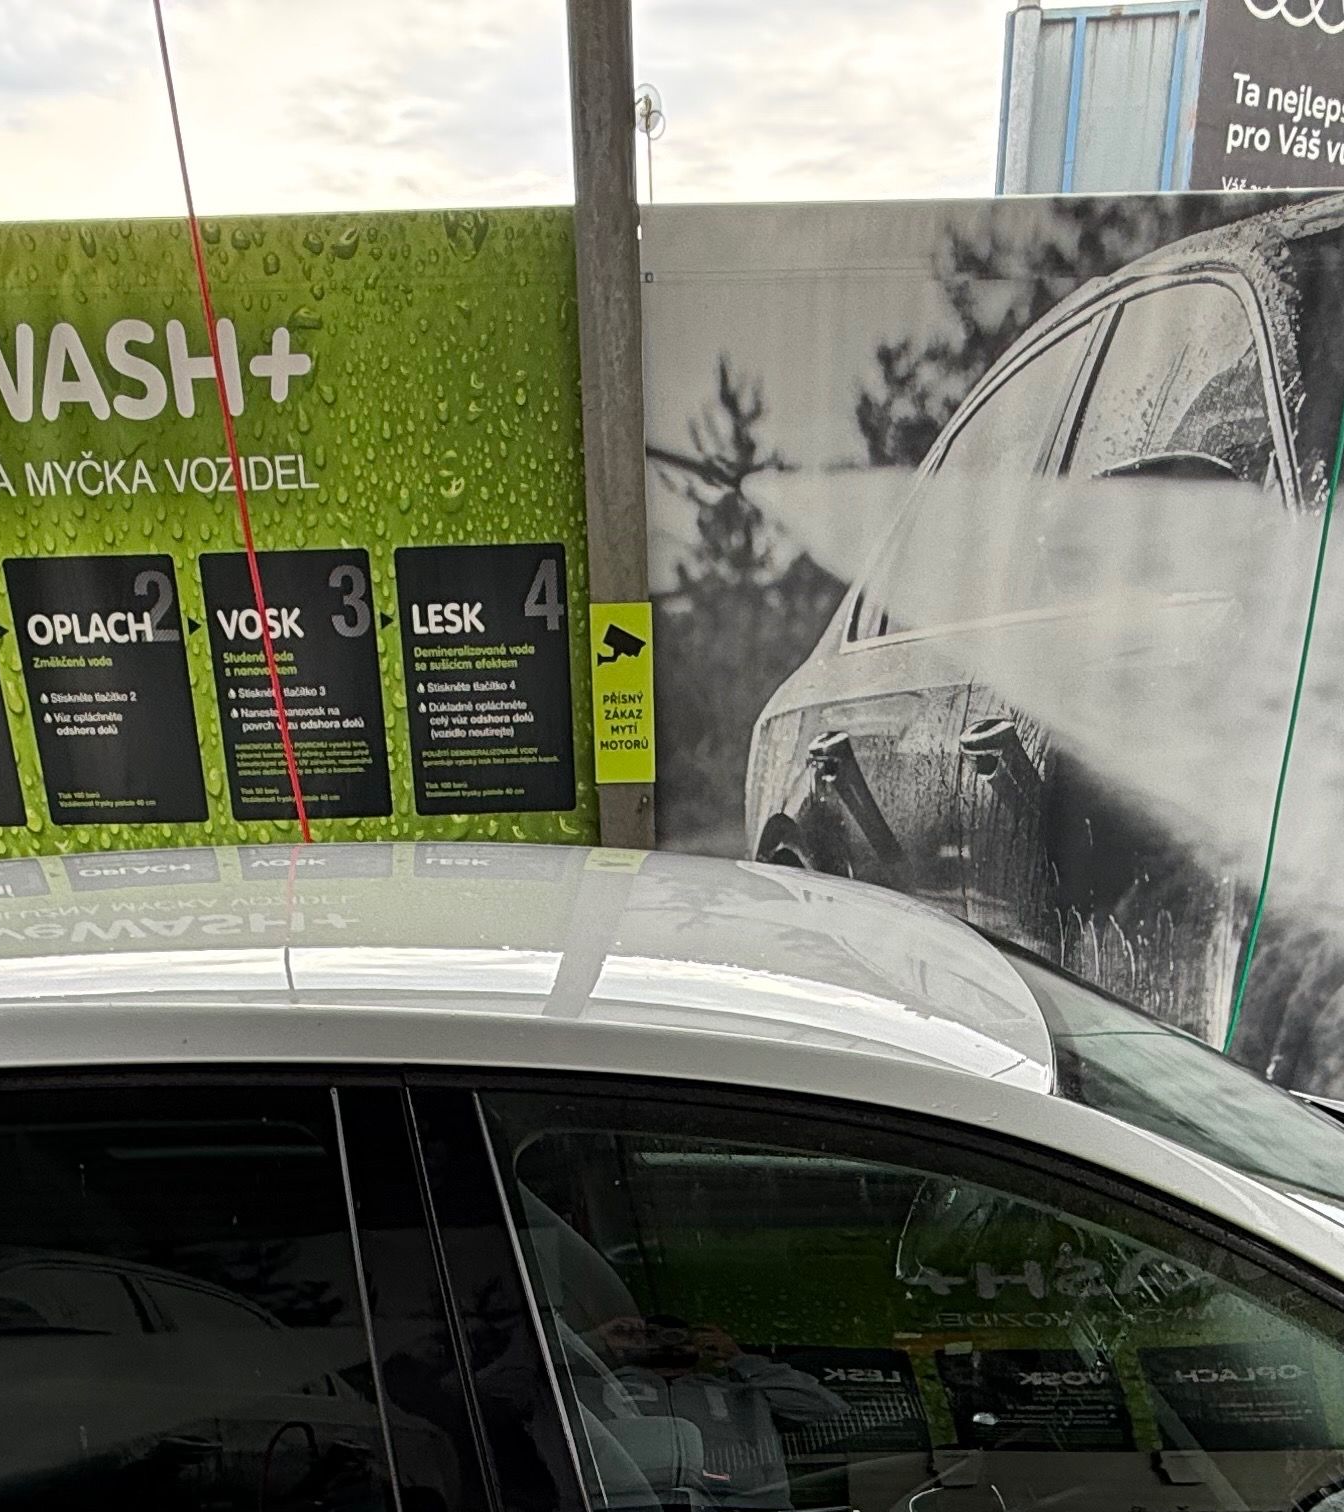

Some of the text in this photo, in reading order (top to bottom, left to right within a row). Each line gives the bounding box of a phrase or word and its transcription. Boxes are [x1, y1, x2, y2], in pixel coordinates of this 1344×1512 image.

[1233, 72, 1260, 108] Ta
[1226, 122, 1271, 154] pro
[1278, 123, 1321, 160] Váš
[25, 450, 157, 498] MYČKA
[164, 453, 320, 494] VOZIDEL
[327, 564, 370, 639] 3
[524, 558, 565, 632] 4
[133, 569, 181, 643] 2
[216, 606, 305, 641] VOSK
[411, 601, 486, 636] LESK
[27, 609, 156, 646] OPLACH
[269, 651, 294, 662] oda
[509, 643, 535, 656] voda
[88, 655, 113, 667] voda
[319, 686, 326, 696] 3
[509, 680, 516, 690] 4
[130, 691, 137, 702] 2
[602, 691, 644, 705] PŘÍSNÝ
[604, 706, 643, 720] ZÁKAZ
[610, 721, 638, 734] MYTÍ
[600, 735, 649, 750] MOTORŮ
